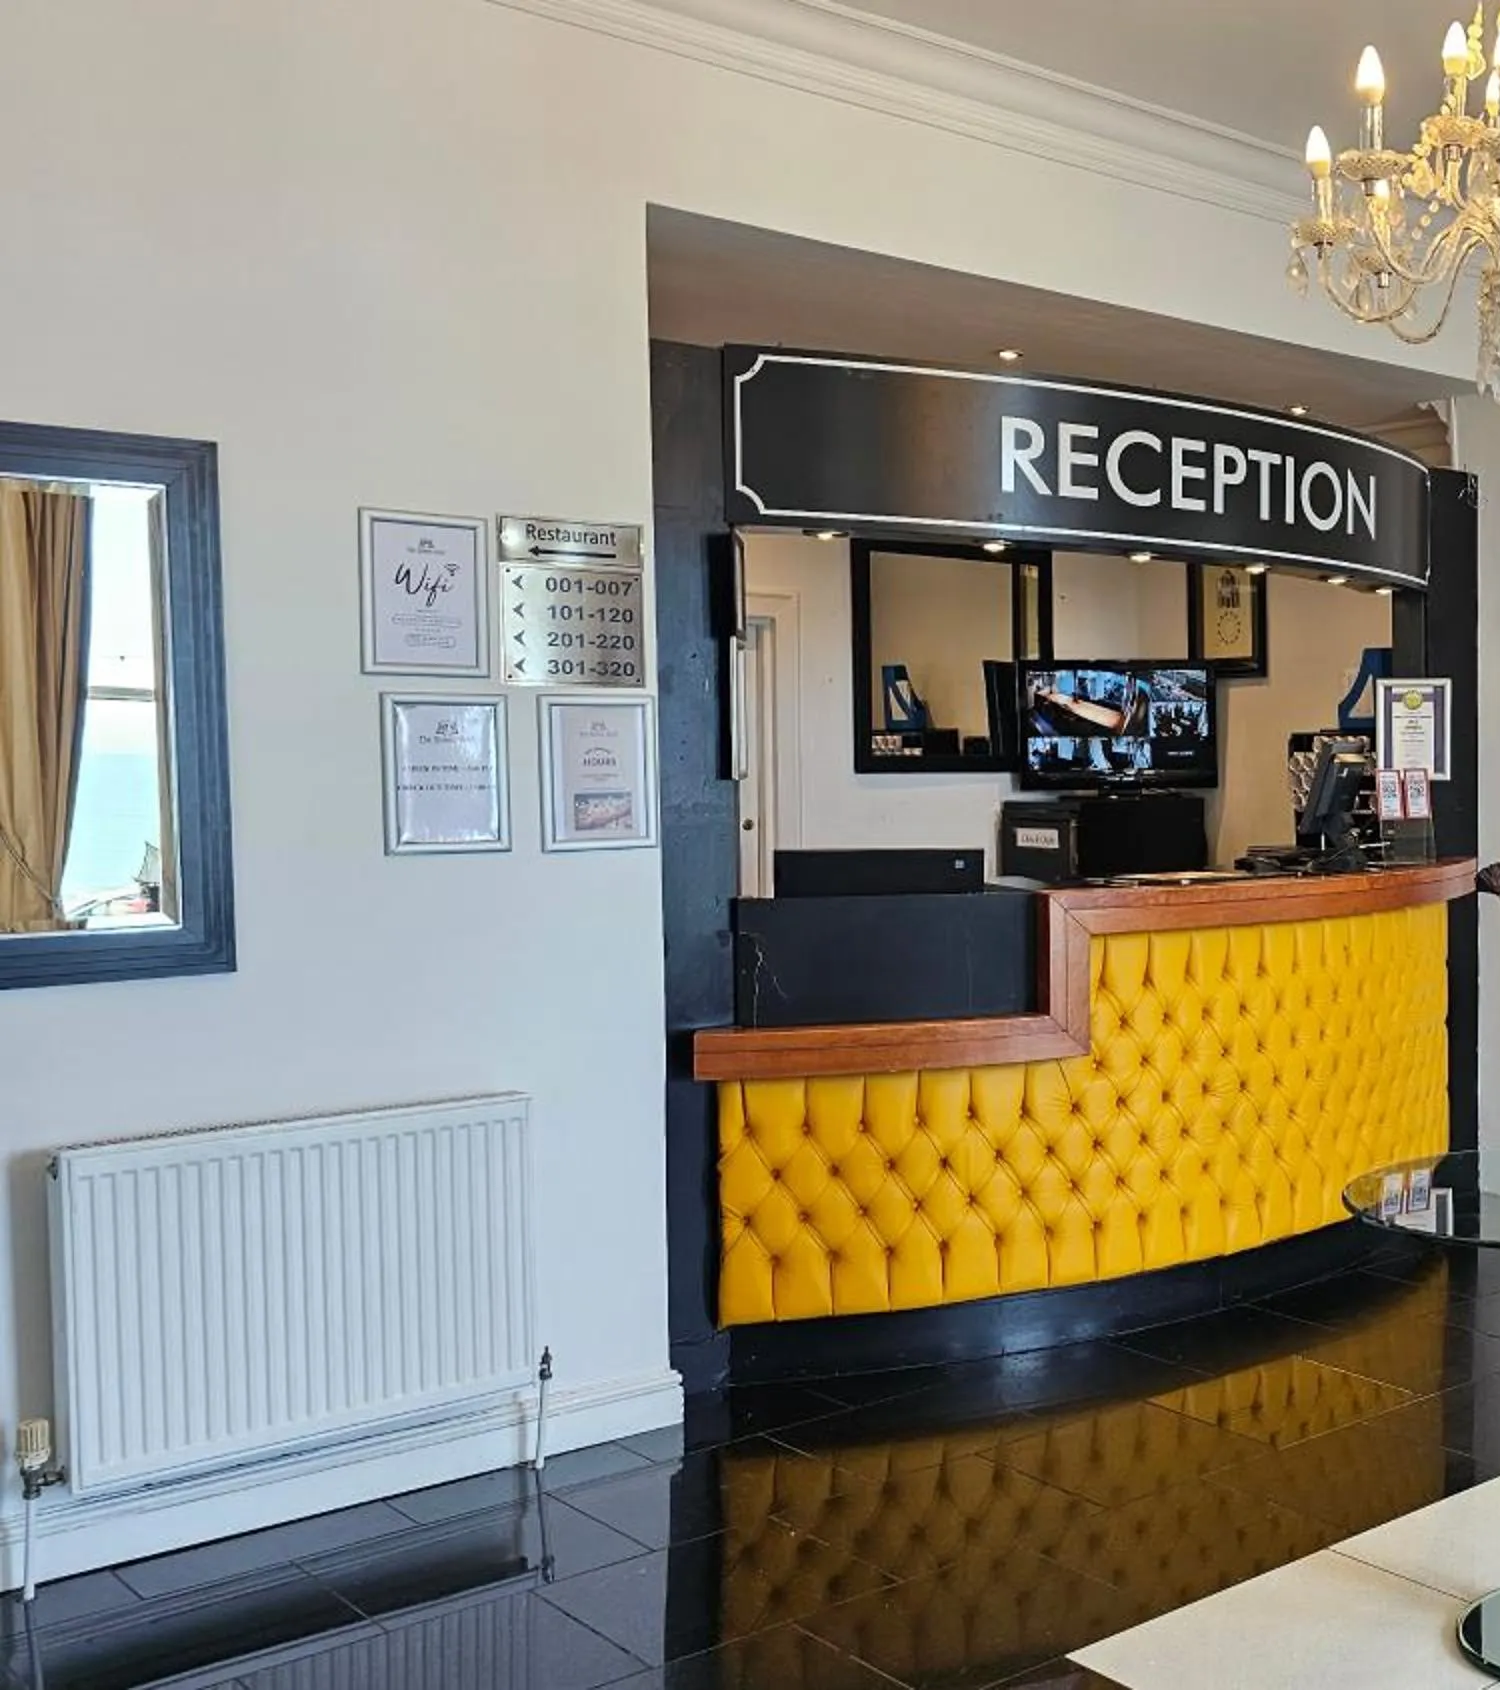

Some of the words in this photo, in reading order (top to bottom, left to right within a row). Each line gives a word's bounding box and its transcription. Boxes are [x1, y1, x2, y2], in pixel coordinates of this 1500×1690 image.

[1001, 415, 1377, 541] RECEPTION
[525, 523, 617, 546] Restaurant
[394, 562, 457, 608] Wifi
[545, 576, 633, 597] 001-007
[546, 605, 634, 623] 101-120
[546, 631, 635, 651] 201-220
[547, 659, 636, 677] 301-320
